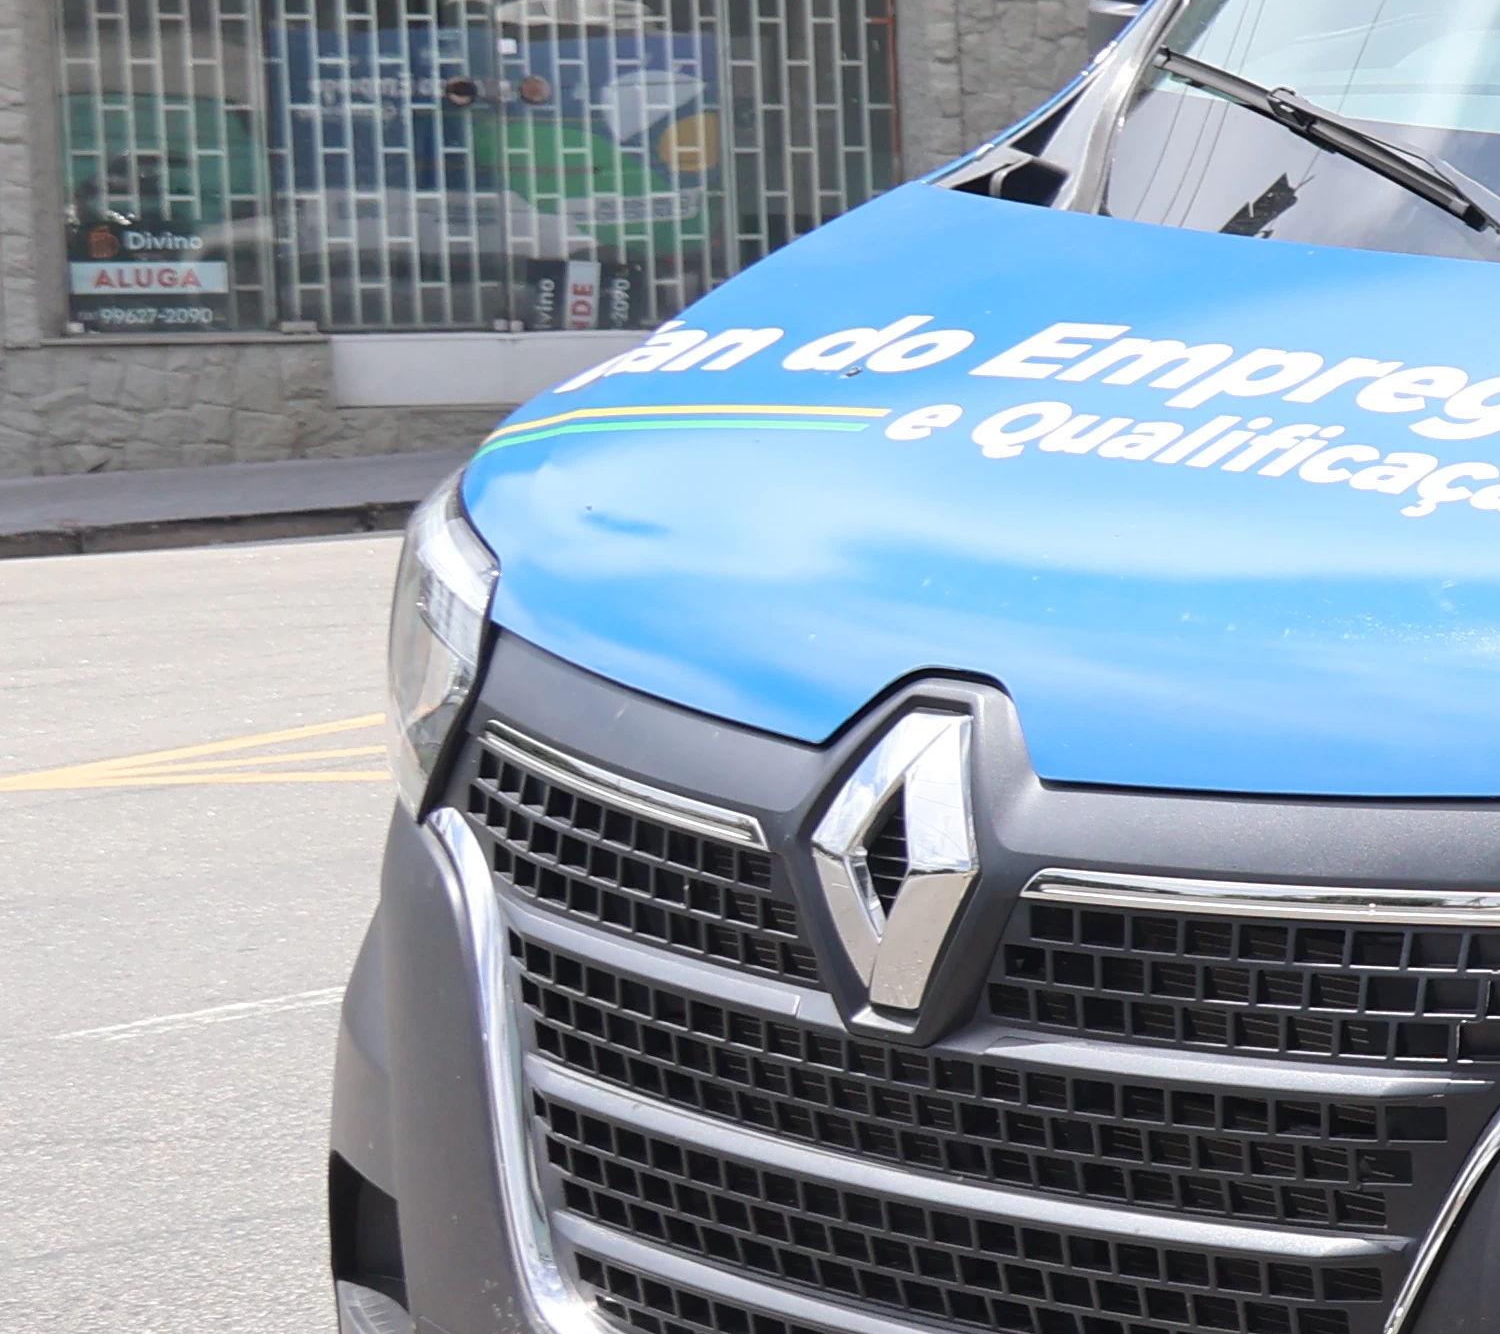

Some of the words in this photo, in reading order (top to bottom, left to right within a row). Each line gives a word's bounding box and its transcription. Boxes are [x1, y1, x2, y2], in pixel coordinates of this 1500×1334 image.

[124, 230, 203, 250] Divino
[94, 268, 201, 288] ALUGA
[100, 307, 214, 324] 99627-2090
[782, 313, 976, 376] do
[884, 402, 962, 443] e
